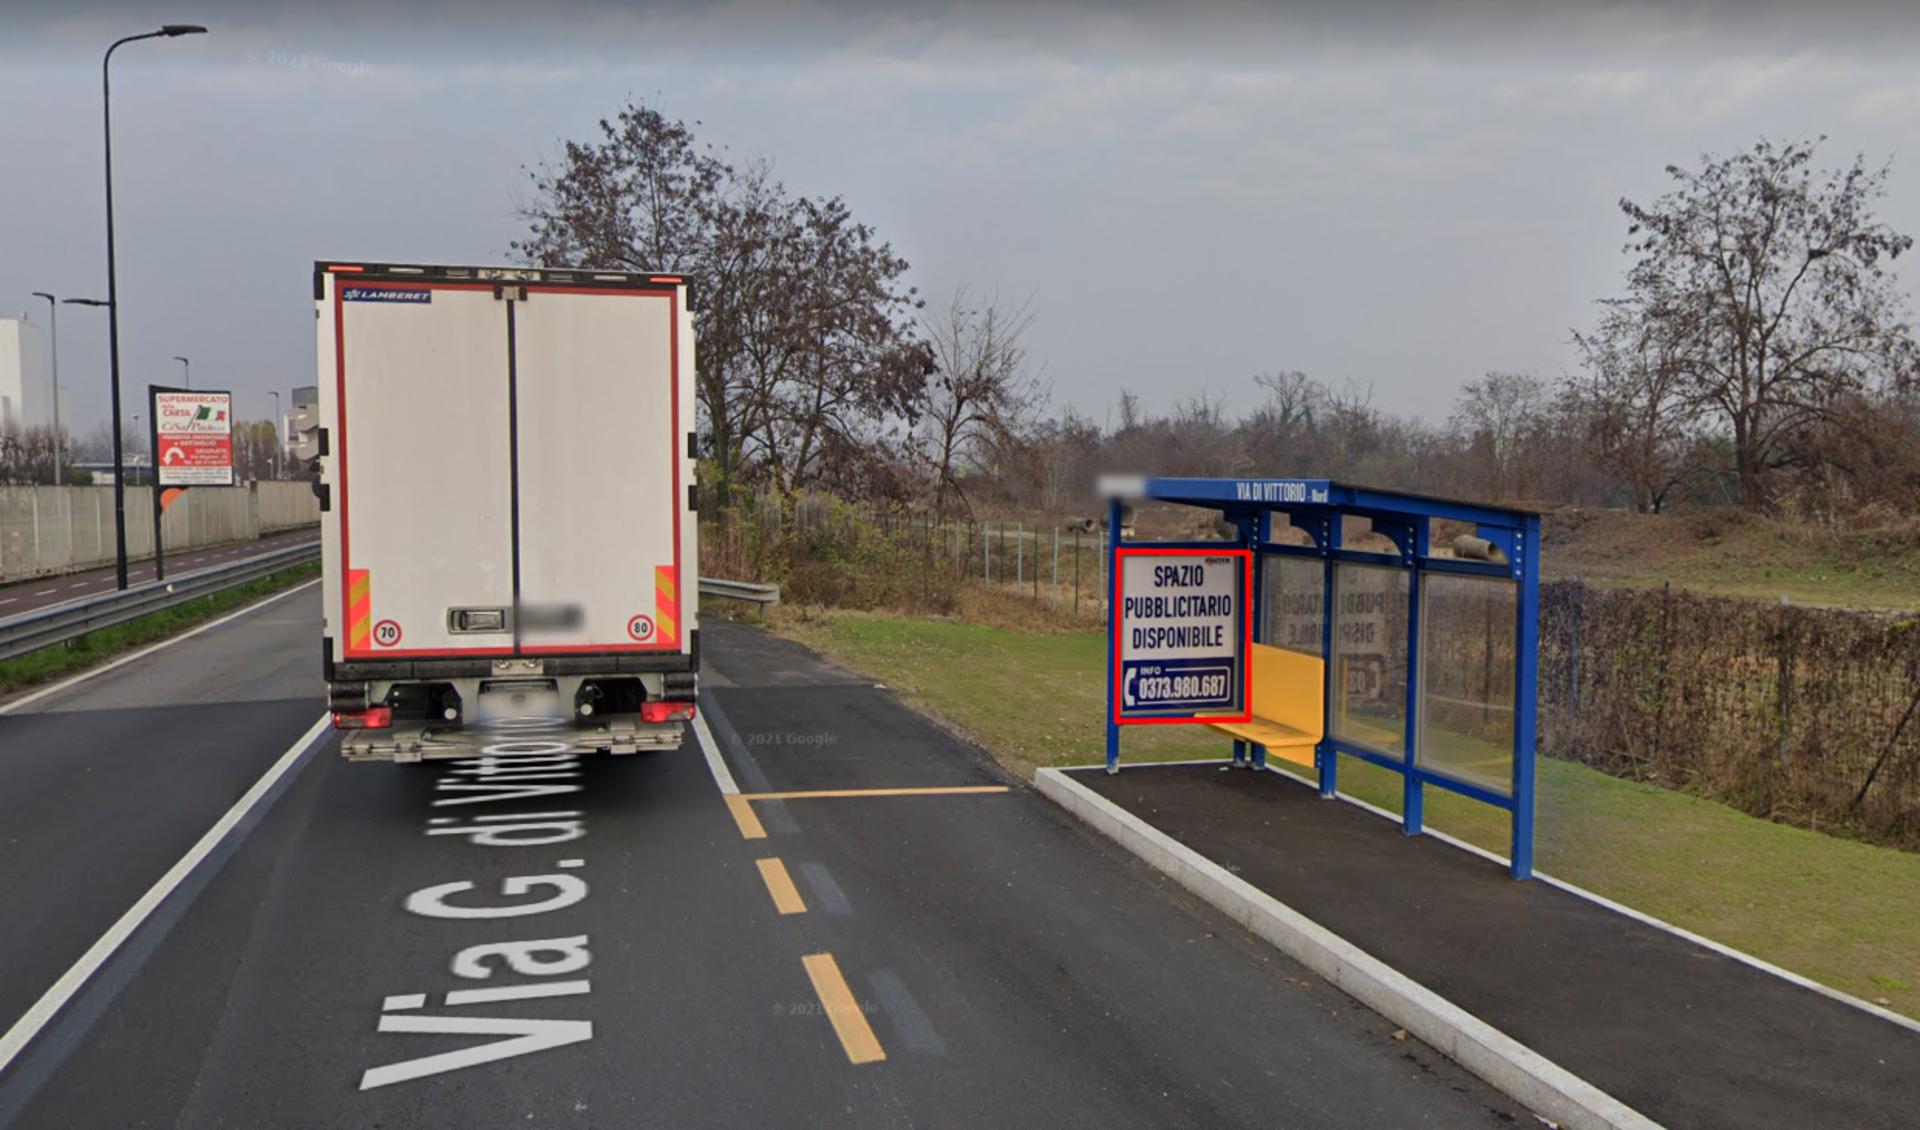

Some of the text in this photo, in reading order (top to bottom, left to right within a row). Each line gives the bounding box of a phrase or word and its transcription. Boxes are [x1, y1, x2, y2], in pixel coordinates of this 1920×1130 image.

[361, 291, 430, 300] LAMBERET
[158, 395, 228, 403] SUPERMERCATO
[1236, 482, 1251, 500] VIA
[1253, 482, 1262, 500] DI
[1264, 483, 1306, 502] VITTORIO
[1154, 565, 1204, 588] SPAZIO
[1125, 595, 1231, 619] PUBBLICITARIO
[381, 626, 395, 638] 70
[634, 622, 648, 633] 80
[1133, 625, 1223, 649] DISPONIBILE
[1140, 666, 1161, 675] INFO
[1140, 675, 1225, 699] 0373.980.687
